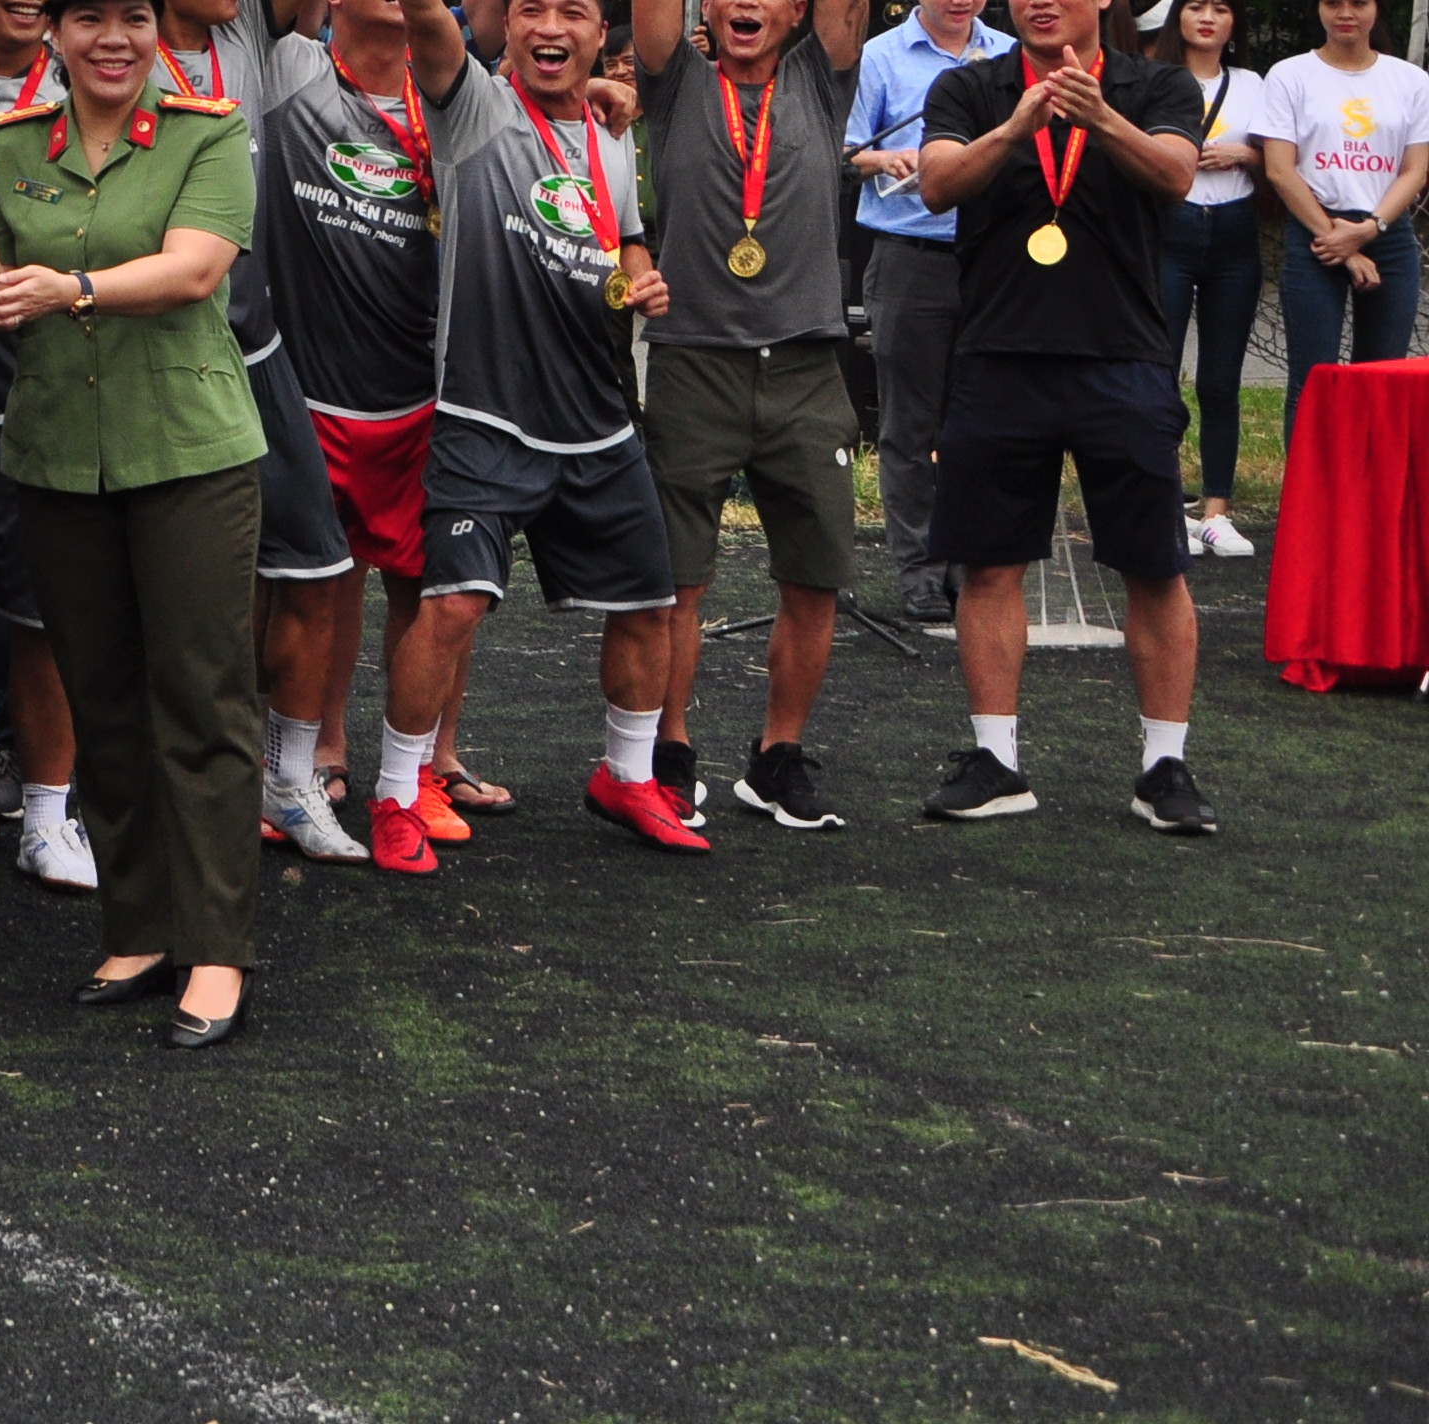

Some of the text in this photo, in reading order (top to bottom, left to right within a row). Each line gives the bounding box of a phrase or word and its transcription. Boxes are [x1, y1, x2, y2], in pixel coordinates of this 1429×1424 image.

[1343, 140, 1370, 153] BIA
[1314, 151, 1395, 174] SAIGON
[293, 180, 425, 231] NHỰA TIỀN PHON
